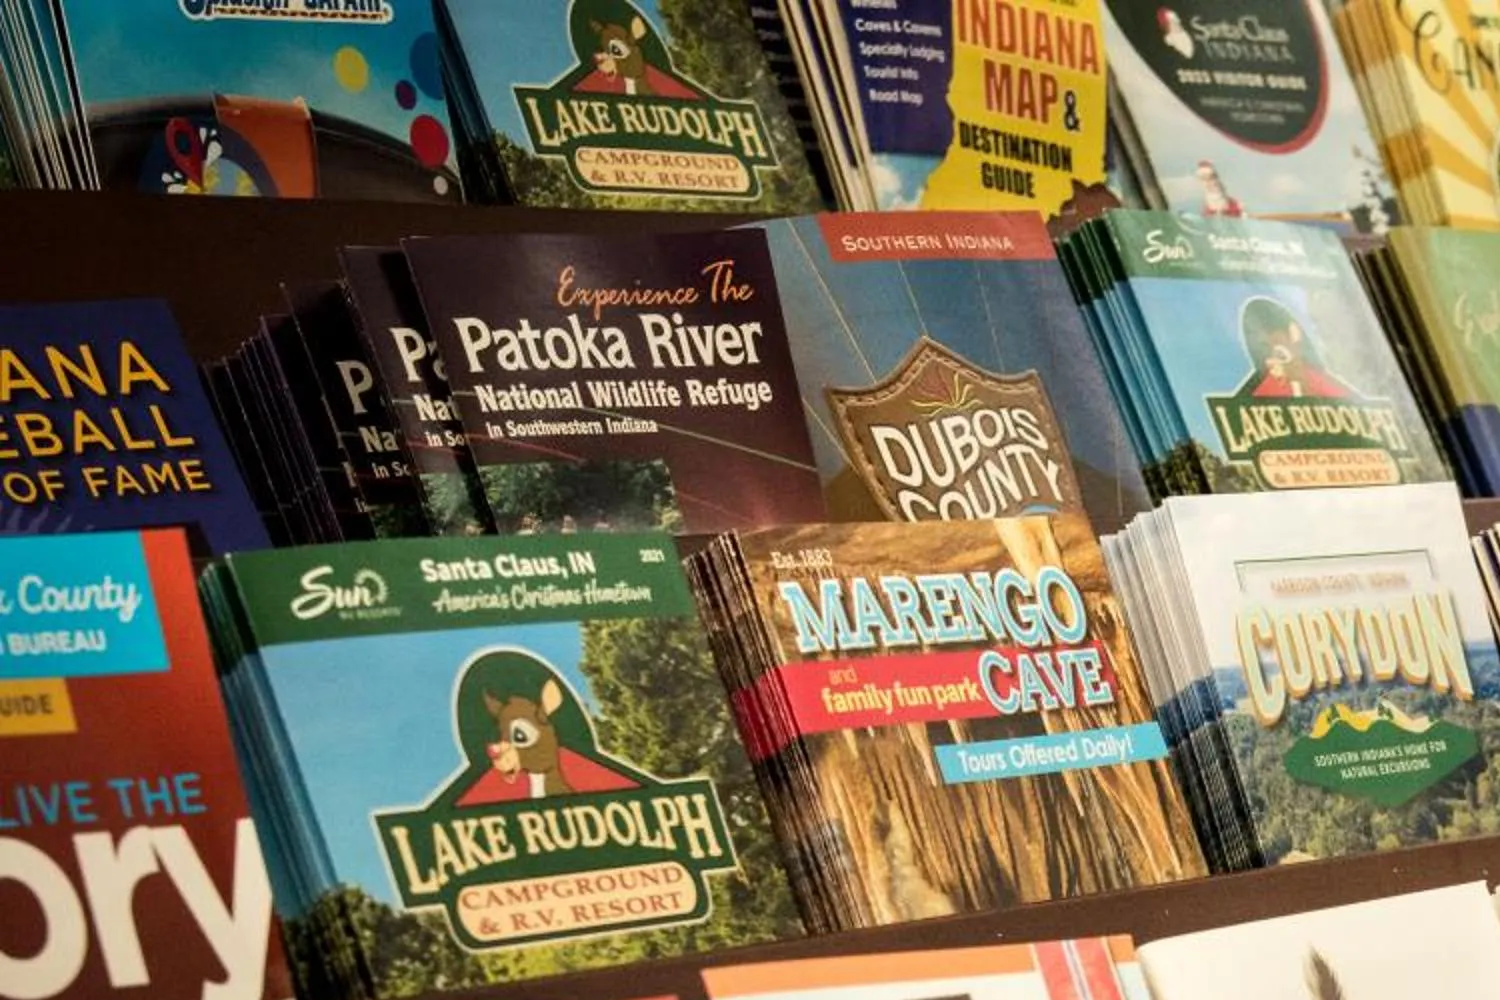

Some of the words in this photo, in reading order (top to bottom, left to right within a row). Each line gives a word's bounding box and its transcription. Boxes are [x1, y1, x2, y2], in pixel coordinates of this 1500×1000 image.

[954, 0, 1100, 75] INDIANA
[983, 59, 1058, 125] MAP
[1063, 90, 1081, 132] &
[526, 97, 617, 148] LAKE
[619, 101, 767, 158] RUDOLPH
[959, 122, 1073, 174] DESTINATION
[577, 150, 740, 172] CAMPGROUND
[590, 172, 609, 184] &
[657, 172, 740, 189] RESORT
[981, 161, 1036, 199] GUIDE
[840, 233, 942, 252] SOUTHERN
[945, 233, 1015, 251] INDIANA
[556, 265, 700, 321] Experience
[702, 259, 754, 302] The
[453, 313, 636, 373] Patoka
[638, 311, 764, 369] River
[474, 381, 585, 413] National
[586, 378, 682, 410] Wildlife
[685, 378, 774, 412] Refuge
[505, 418, 604, 438] Southwestern
[605, 415, 660, 434] Indiana
[871, 407, 1049, 489] DUBOIS
[1216, 405, 1292, 453] LAKE
[1294, 405, 1408, 452] RUDOLPH
[3, 470, 65, 504] OF
[82, 459, 212, 498] FAME
[1261, 452, 1387, 466] CAMPGROUND
[896, 442, 1064, 524] COUNTY
[419, 557, 494, 584] Santa
[495, 553, 567, 580] Claus,
[569, 551, 597, 575] IN
[799, 547, 834, 568] 1883
[17, 573, 143, 623] County
[290, 565, 376, 620] Sun
[432, 586, 510, 614] America's
[511, 581, 582, 611] Christmas
[582, 577, 653, 605] Hometown
[777, 563, 1088, 653] MARENGO
[7, 628, 108, 657] BUREAU
[1234, 585, 1474, 729] CORYDON
[821, 681, 896, 717] family
[893, 679, 934, 709] fun
[932, 677, 982, 713] park
[827, 667, 859, 684] and
[977, 647, 1116, 716] CAVE
[956, 748, 1007, 776] Tours
[1010, 740, 1079, 770] Offered
[1082, 736, 1136, 766] Daily!
[1313, 751, 1360, 767] SOUTHERN
[106, 772, 208, 819] THE
[391, 815, 518, 894] LAKE
[517, 793, 723, 860] RUDOLPH
[460, 864, 684, 912] CAMPGROUND
[478, 915, 500, 936] &
[511, 907, 565, 932] R.V.
[571, 891, 684, 924] RESORT
